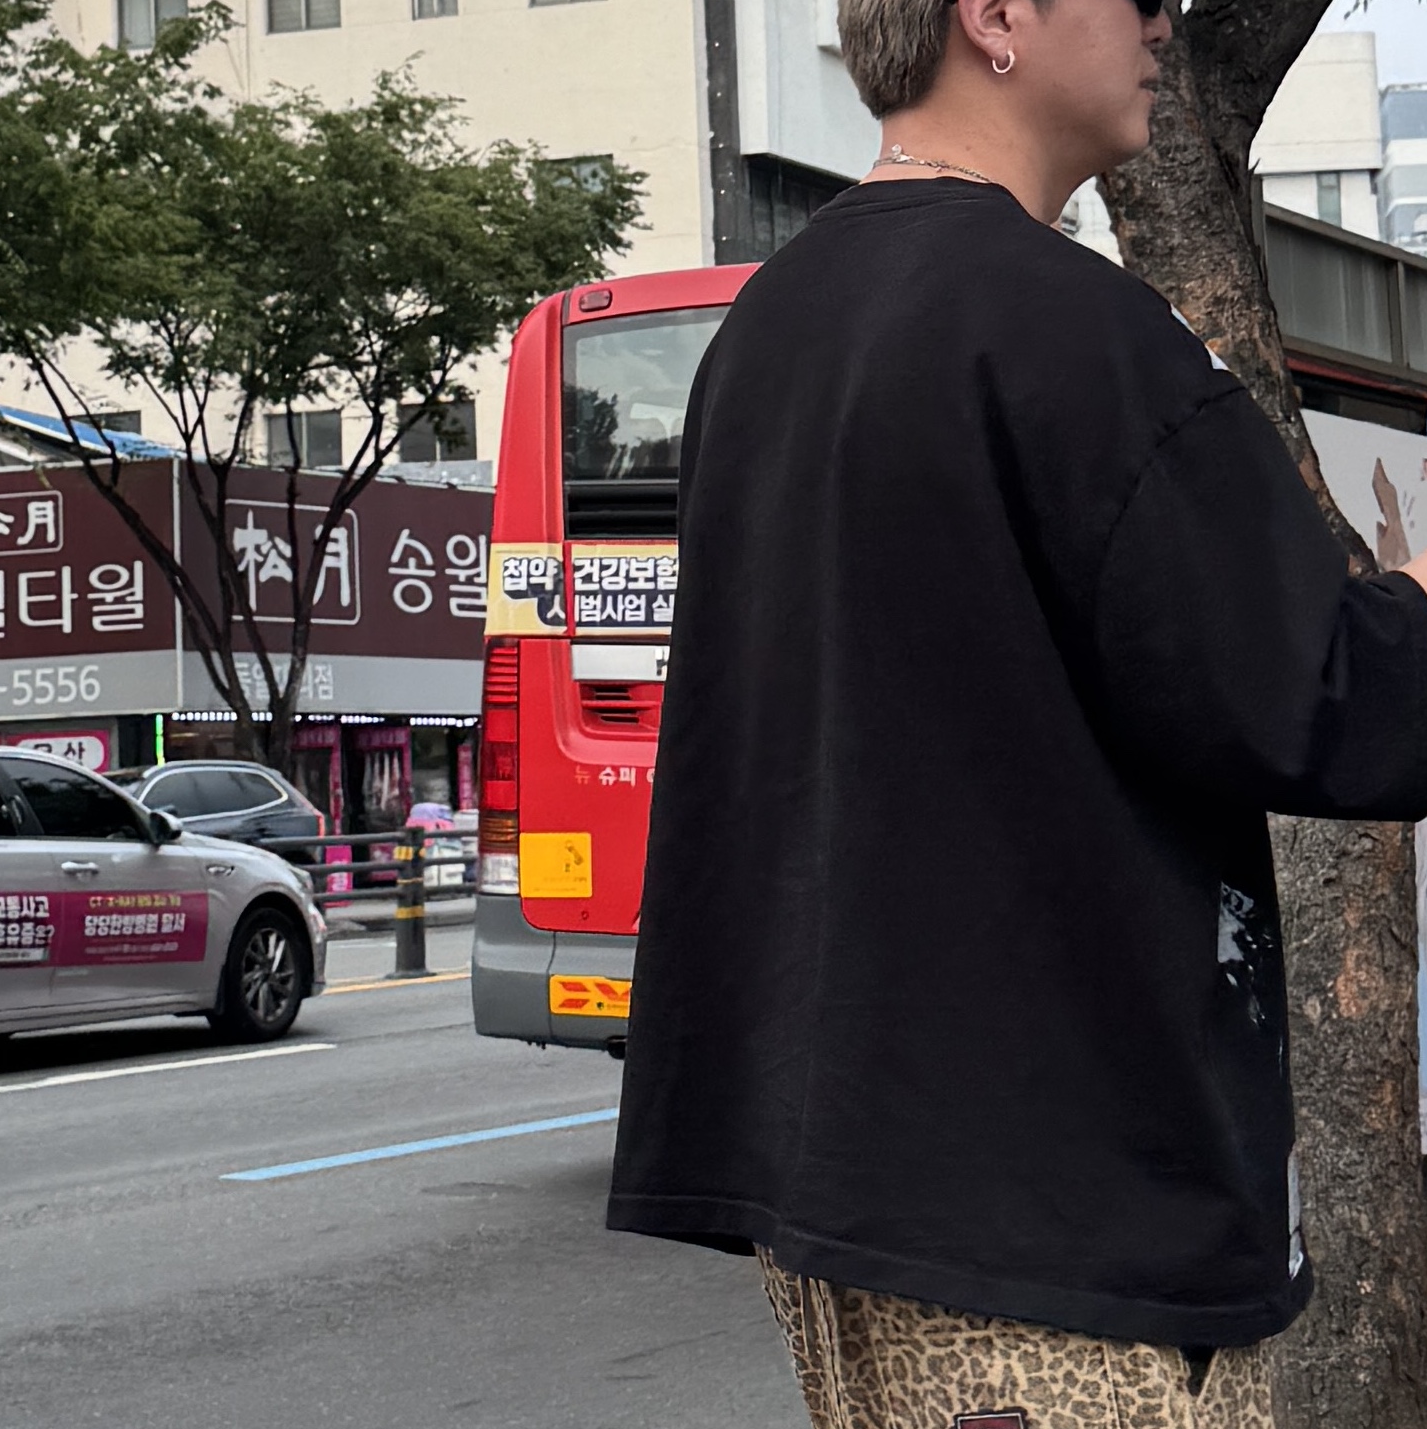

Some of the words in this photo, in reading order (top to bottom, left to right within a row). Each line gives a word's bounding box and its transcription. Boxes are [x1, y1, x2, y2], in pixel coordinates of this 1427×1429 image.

[388, 528, 488, 618] 송월
[503, 556, 560, 592] 첩약
[573, 556, 677, 592] 건강보험
[546, 594, 647, 623] 시범사업
